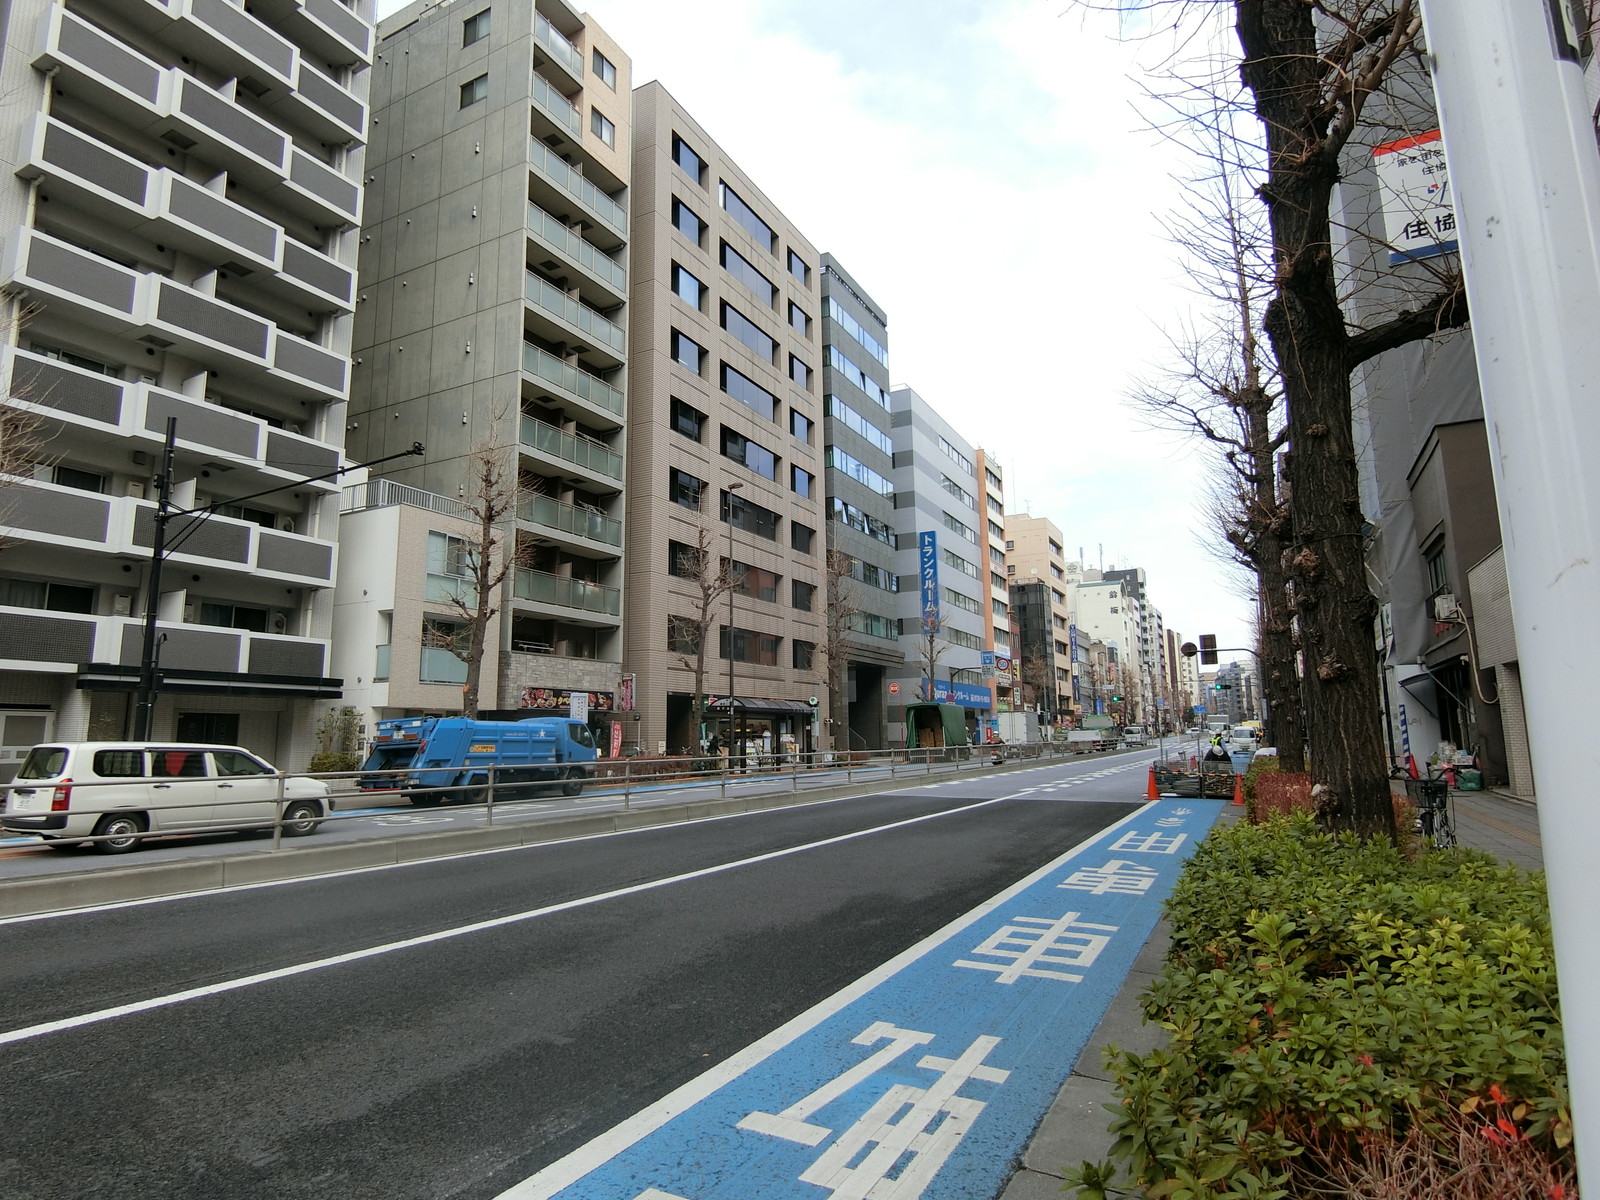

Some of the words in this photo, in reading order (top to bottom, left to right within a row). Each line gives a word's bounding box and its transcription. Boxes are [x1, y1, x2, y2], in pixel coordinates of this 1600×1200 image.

[923, 535, 936, 612] トランクルーム
